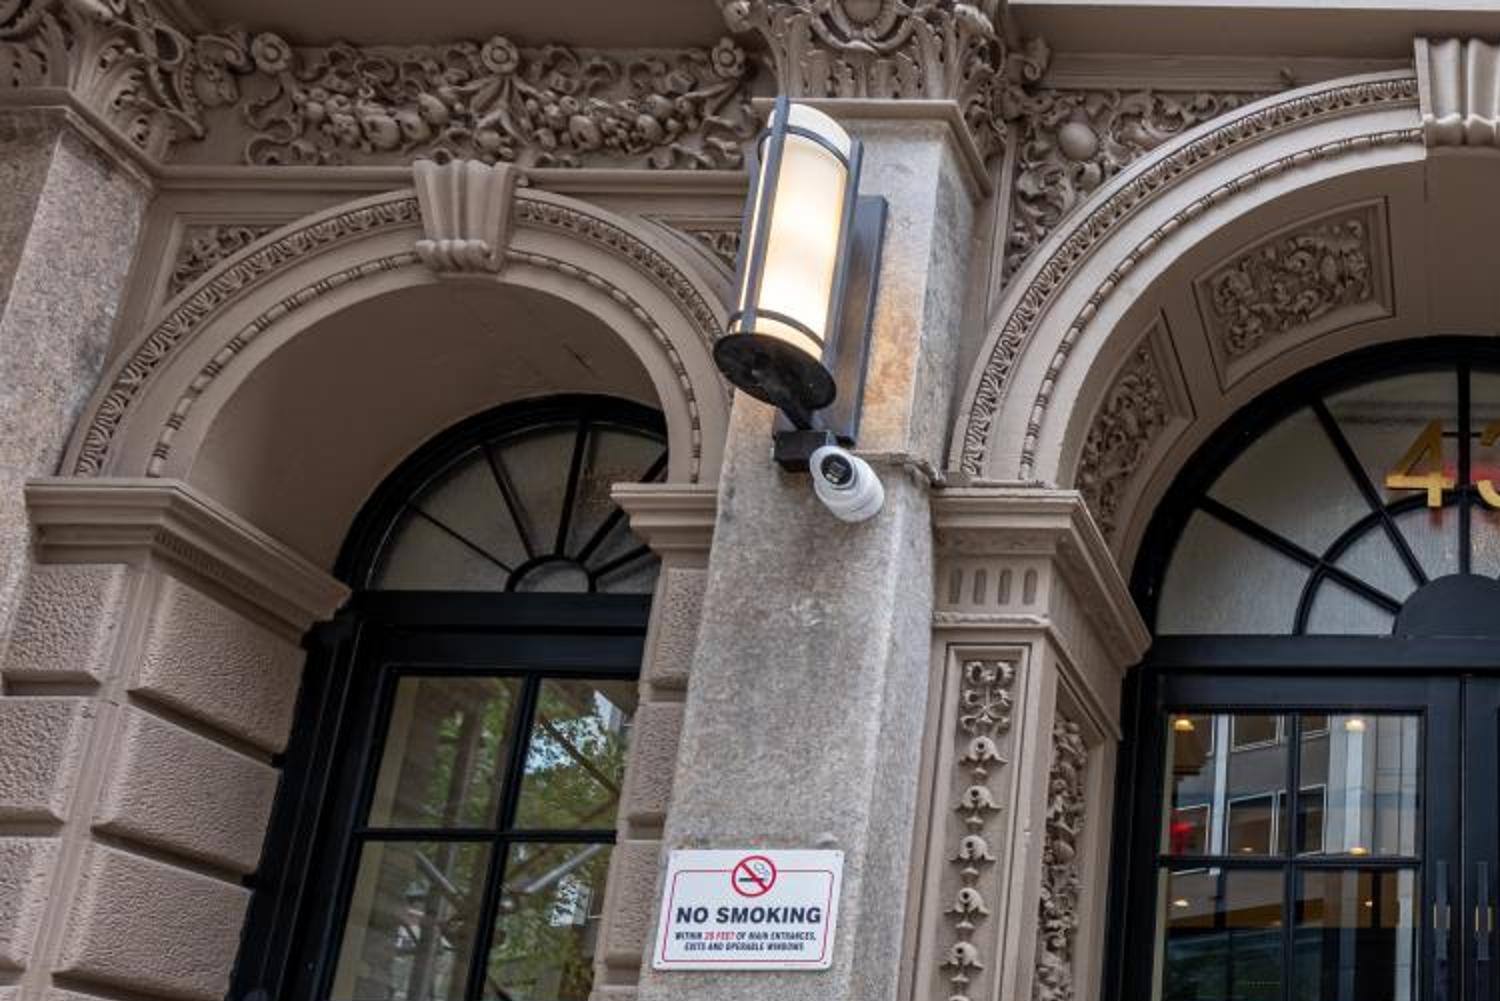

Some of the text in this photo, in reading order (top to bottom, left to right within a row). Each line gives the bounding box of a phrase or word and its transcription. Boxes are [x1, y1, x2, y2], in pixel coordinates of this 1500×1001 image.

[676, 907, 821, 923] NO SMOKING
[675, 932, 702, 940] WITHIN
[715, 932, 736, 940] FEET
[736, 932, 746, 940] OF
[748, 932, 768, 940] MAIN
[685, 942, 804, 951] EXITS AND OPERABLE WINDOWS
